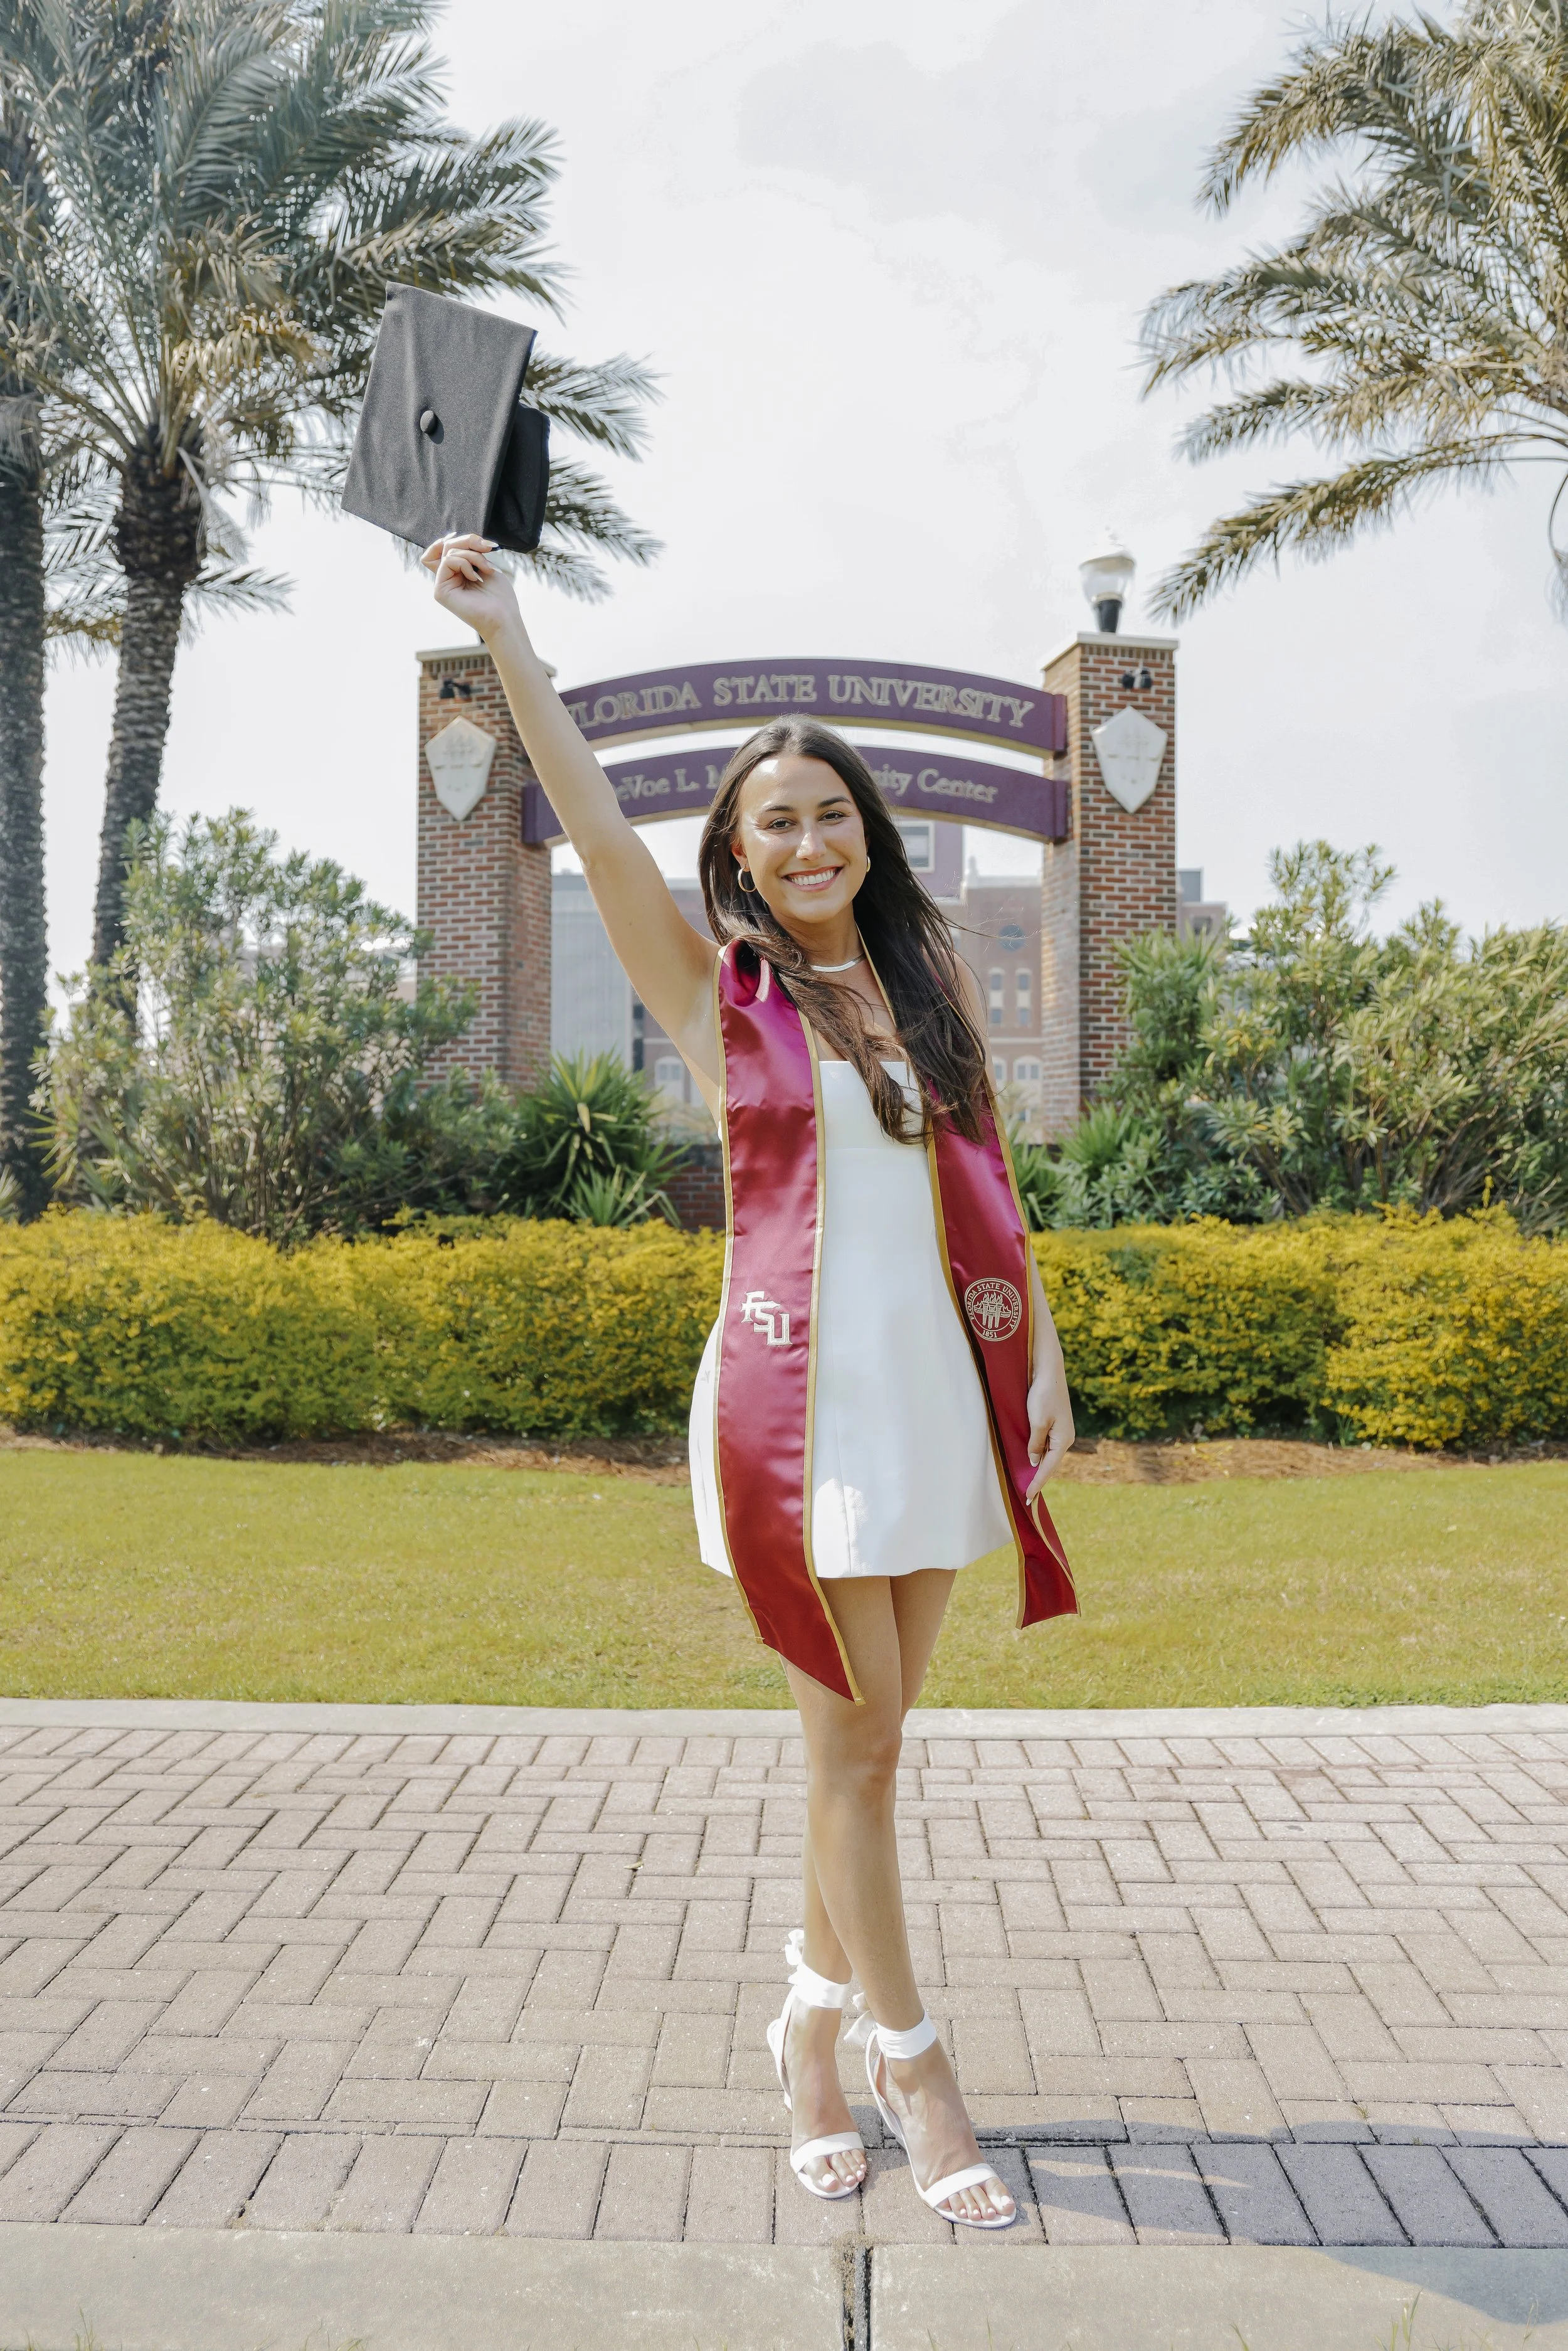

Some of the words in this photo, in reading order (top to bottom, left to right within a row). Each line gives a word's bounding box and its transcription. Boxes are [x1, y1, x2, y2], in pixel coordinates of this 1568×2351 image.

[713, 674, 817, 706] STATE
[828, 675, 1034, 728] UNIVERSITY
[613, 773, 670, 802] eVoe
[917, 768, 999, 804] Center
[741, 1291, 793, 1346] FSU
[967, 1290, 978, 1320] FLORIDA
[977, 1283, 1000, 1292] STATE
[1002, 1286, 1019, 1330] UNIVERSITY
[982, 1330, 997, 1338] 1851
